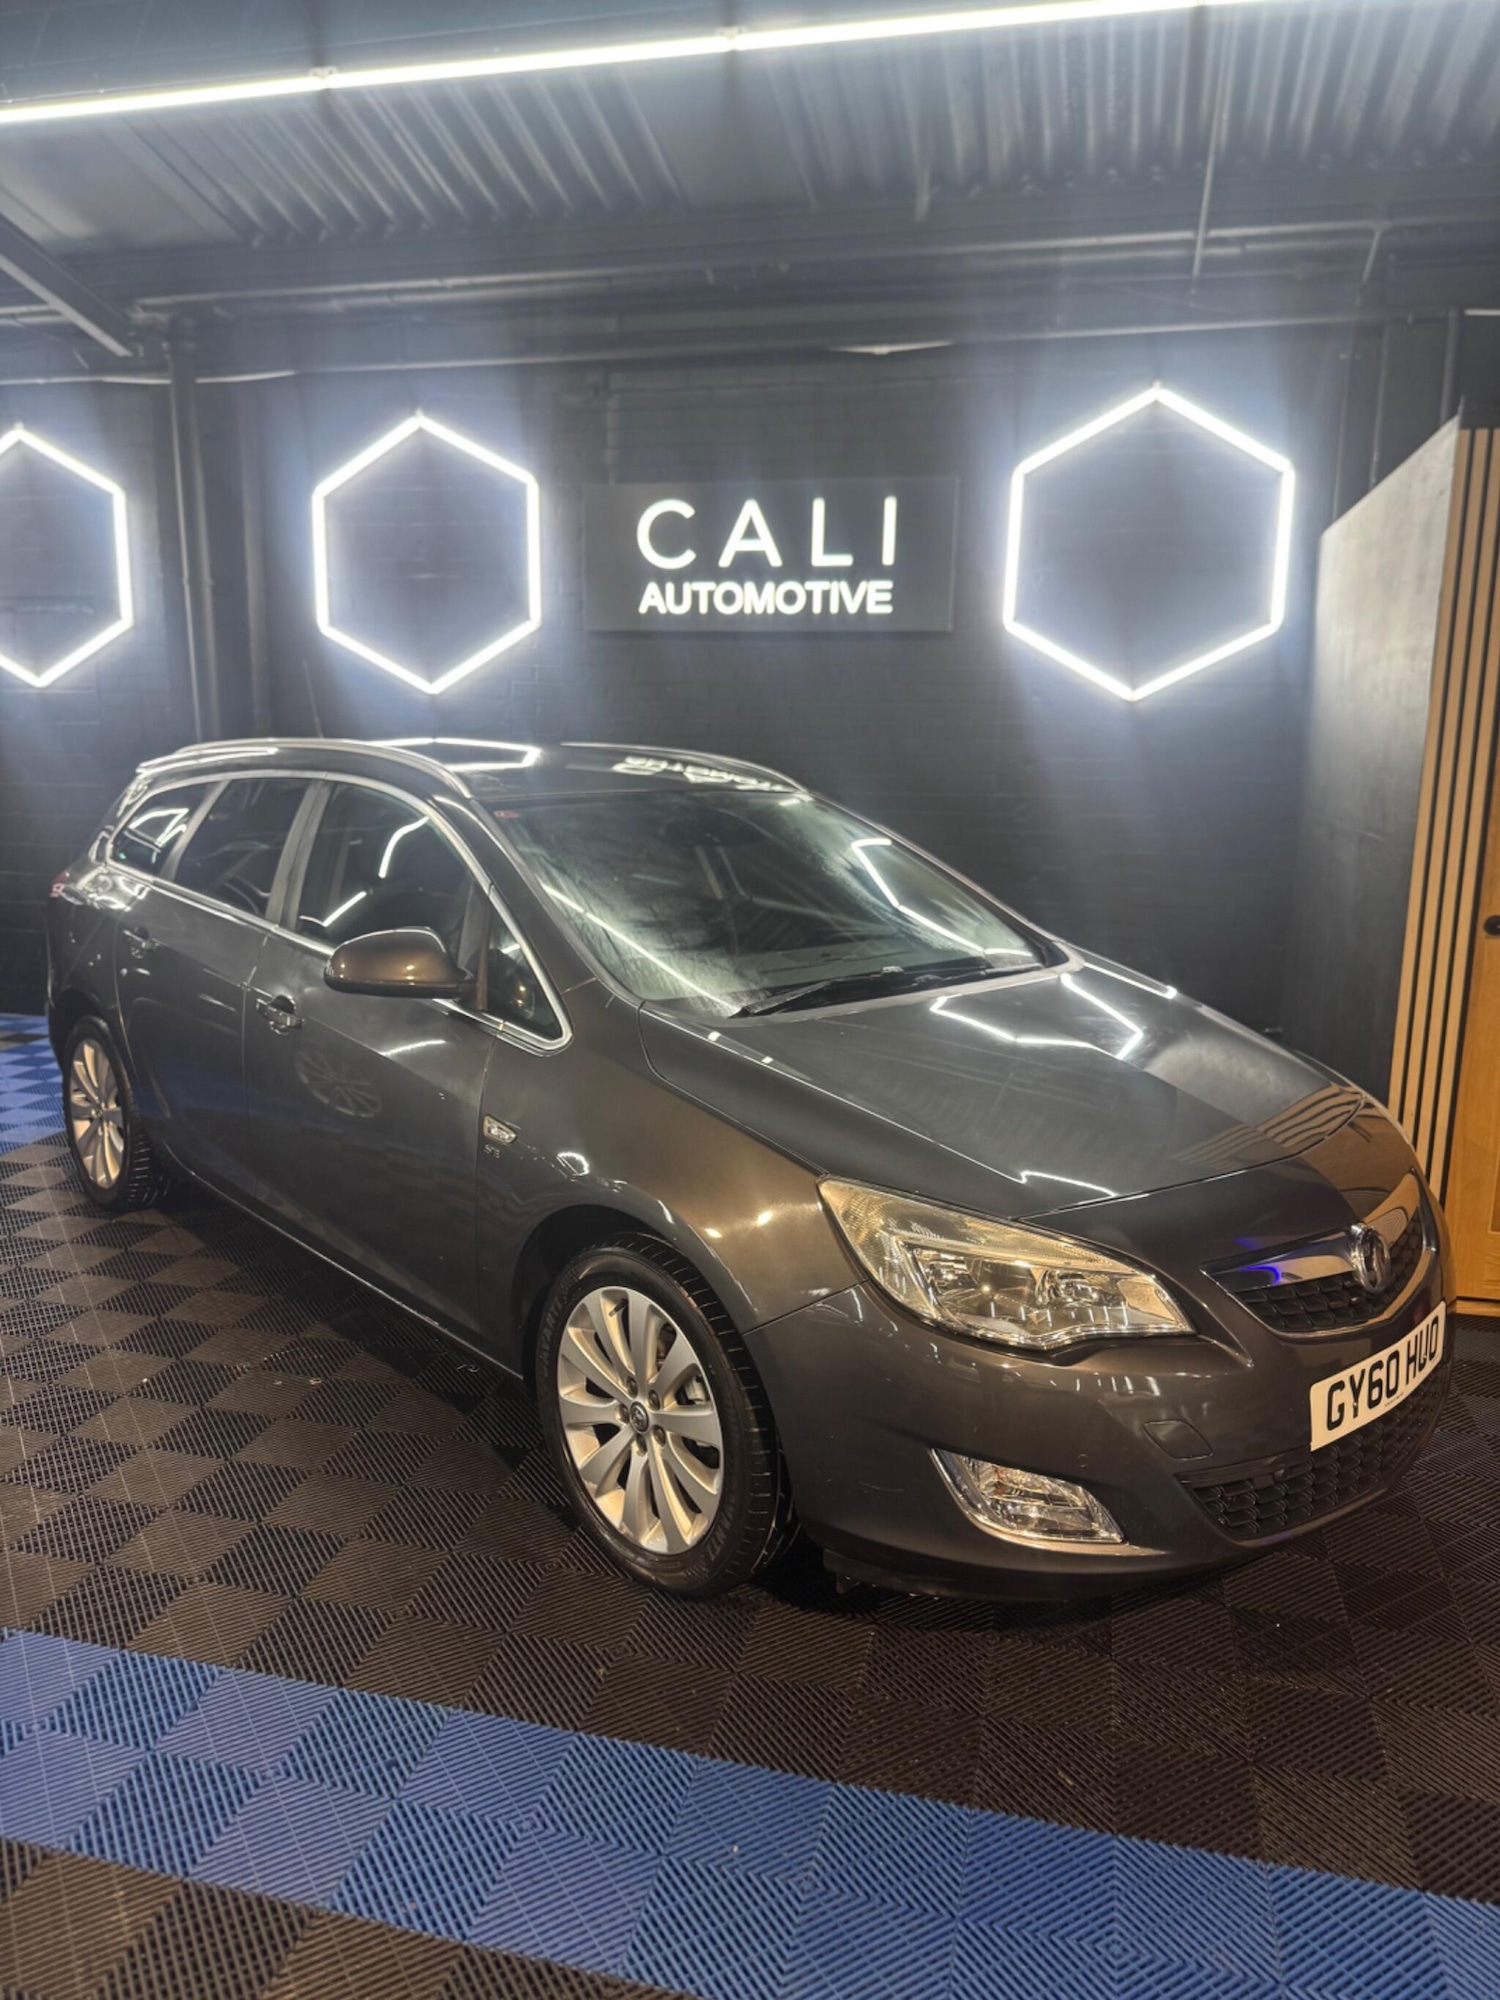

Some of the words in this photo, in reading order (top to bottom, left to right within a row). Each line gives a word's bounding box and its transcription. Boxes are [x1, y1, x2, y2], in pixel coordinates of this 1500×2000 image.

[636, 496, 897, 569] CALI
[638, 580, 894, 614] AUTOMOTIVE
[1327, 1350, 1400, 1431] GY60
[1405, 1315, 1439, 1385] HUO
